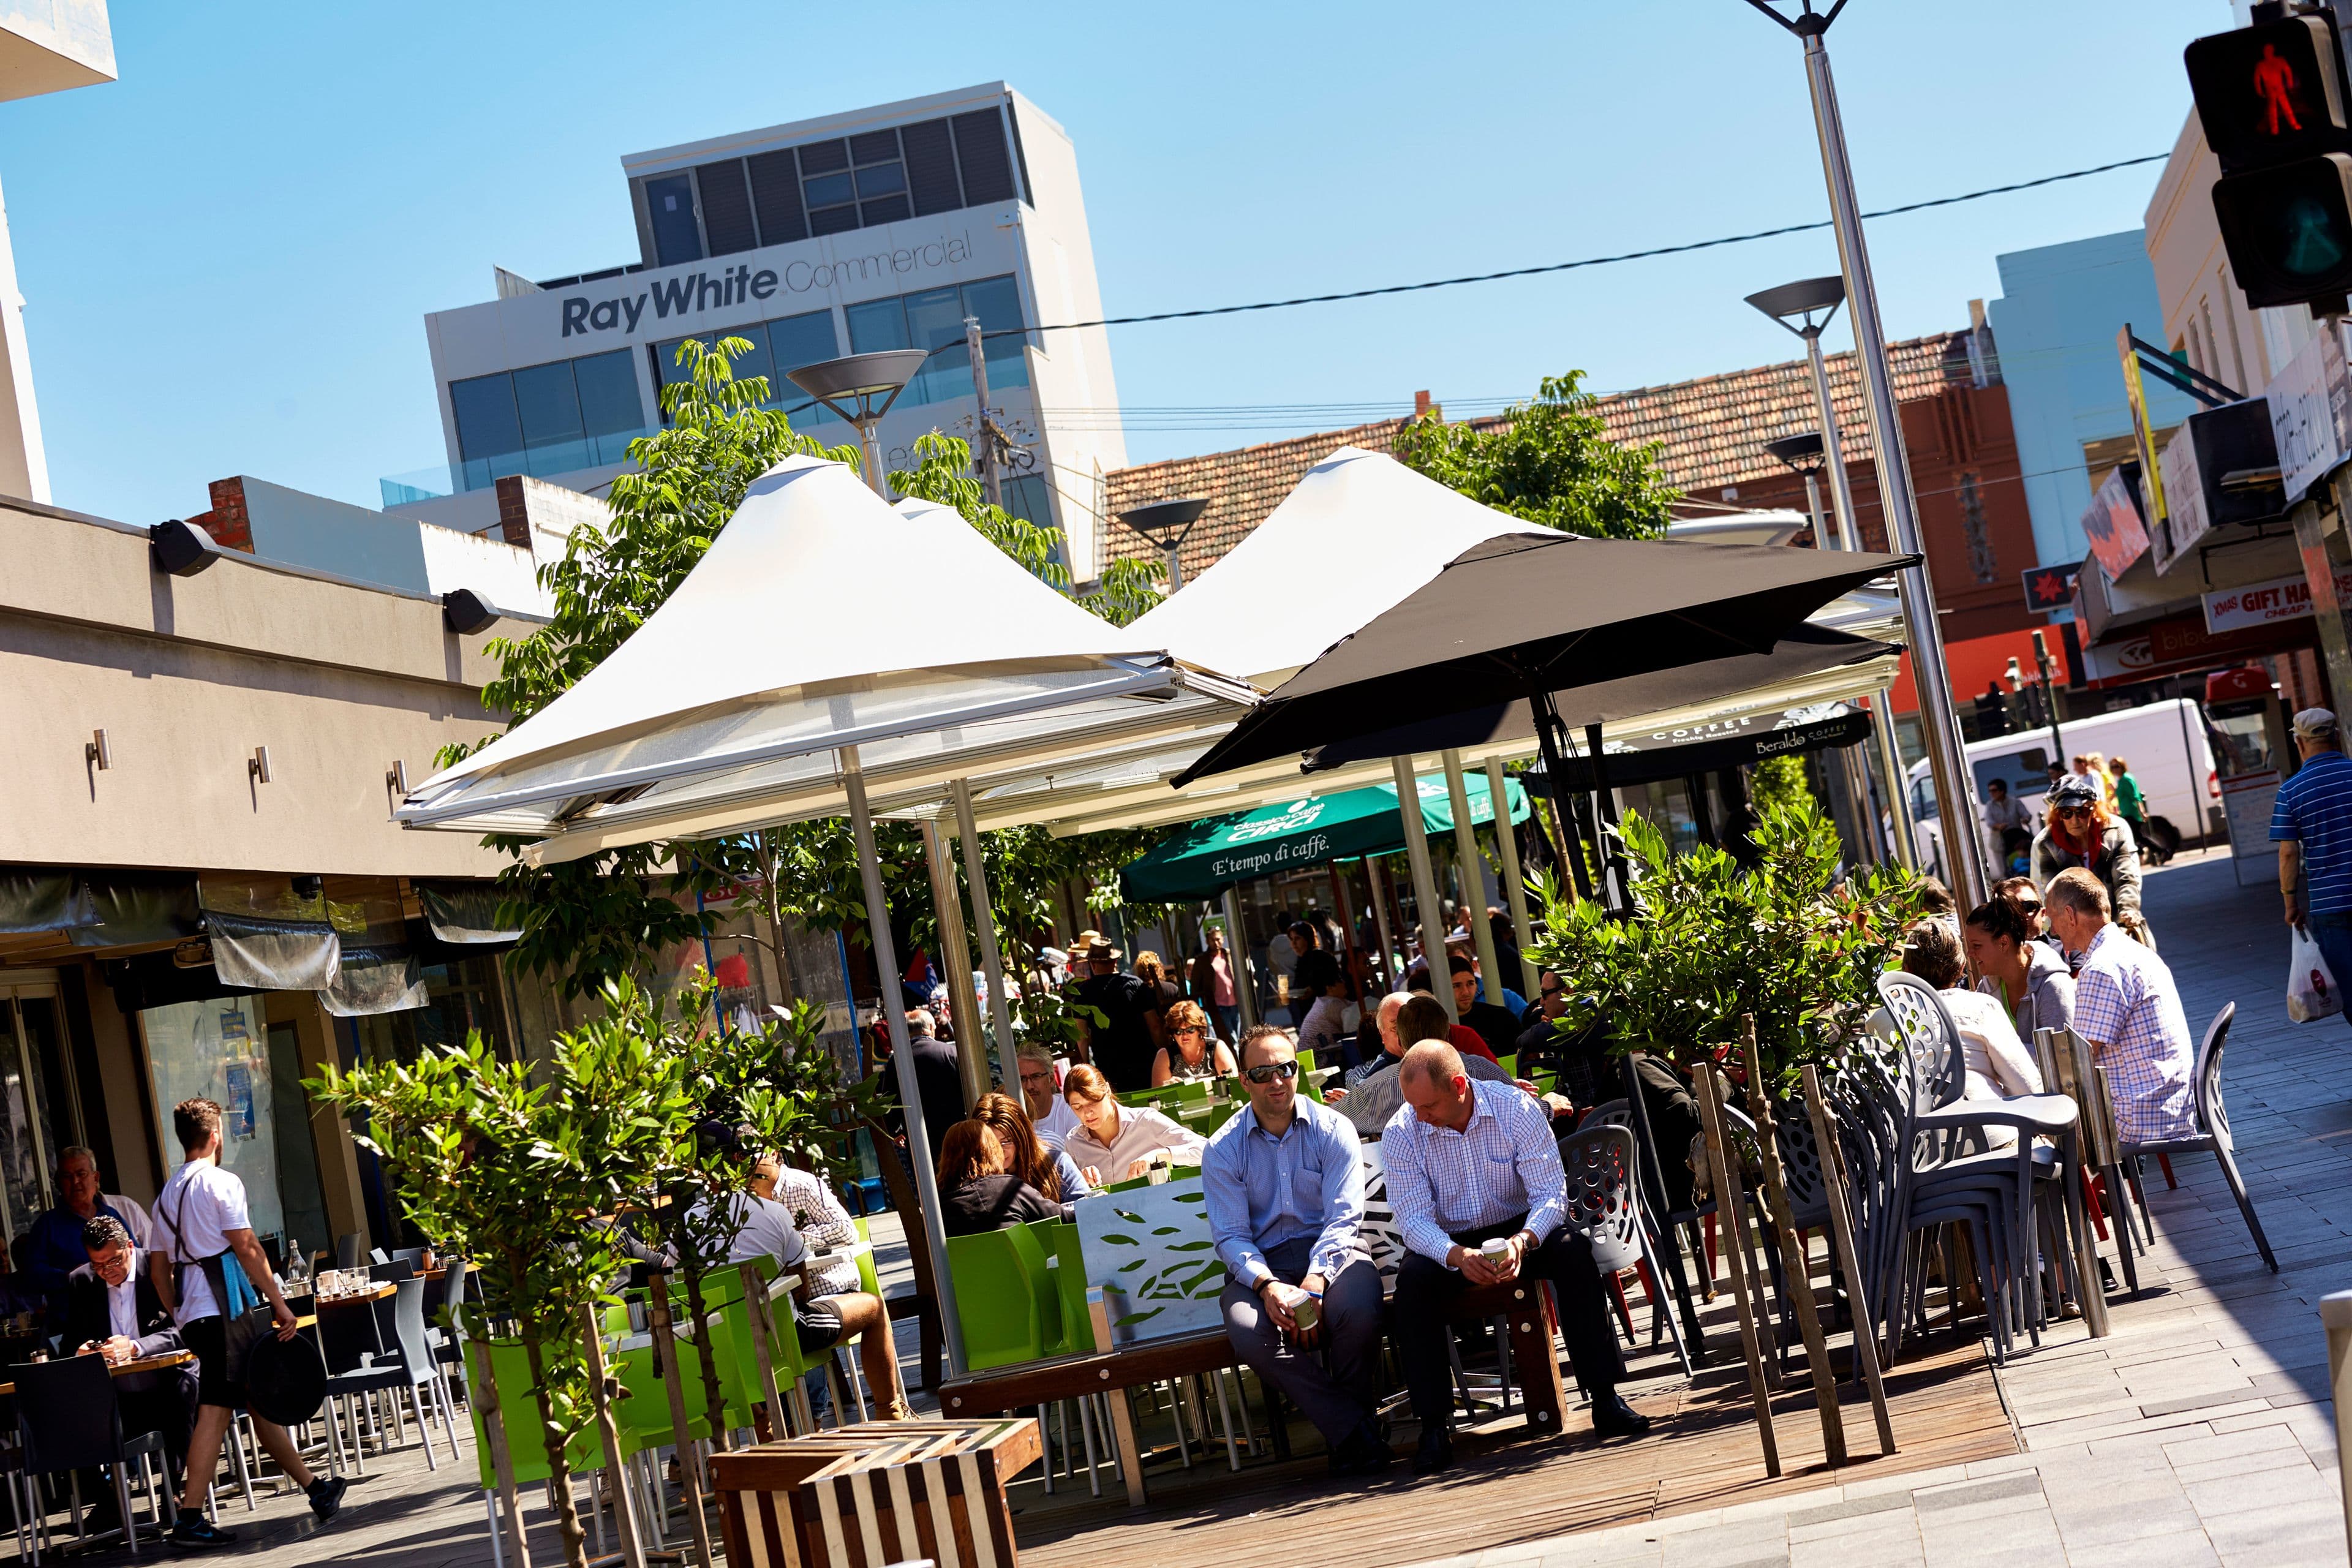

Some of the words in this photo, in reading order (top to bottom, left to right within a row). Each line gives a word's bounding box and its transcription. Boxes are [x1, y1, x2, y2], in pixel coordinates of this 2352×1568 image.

[785, 229, 972, 292] Commercial
[2212, 596, 2237, 618] XMAS
[2241, 587, 2279, 612] GIFT
[2264, 605, 2305, 619] CHEAP
[1653, 717, 1751, 740] COFFEE
[1756, 731, 1806, 754] Beraldo
[1227, 812, 1321, 842] CIRCI
[1233, 815, 1290, 831] classico
[1275, 843, 1289, 861] di
[1292, 834, 1330, 860] caffè.
